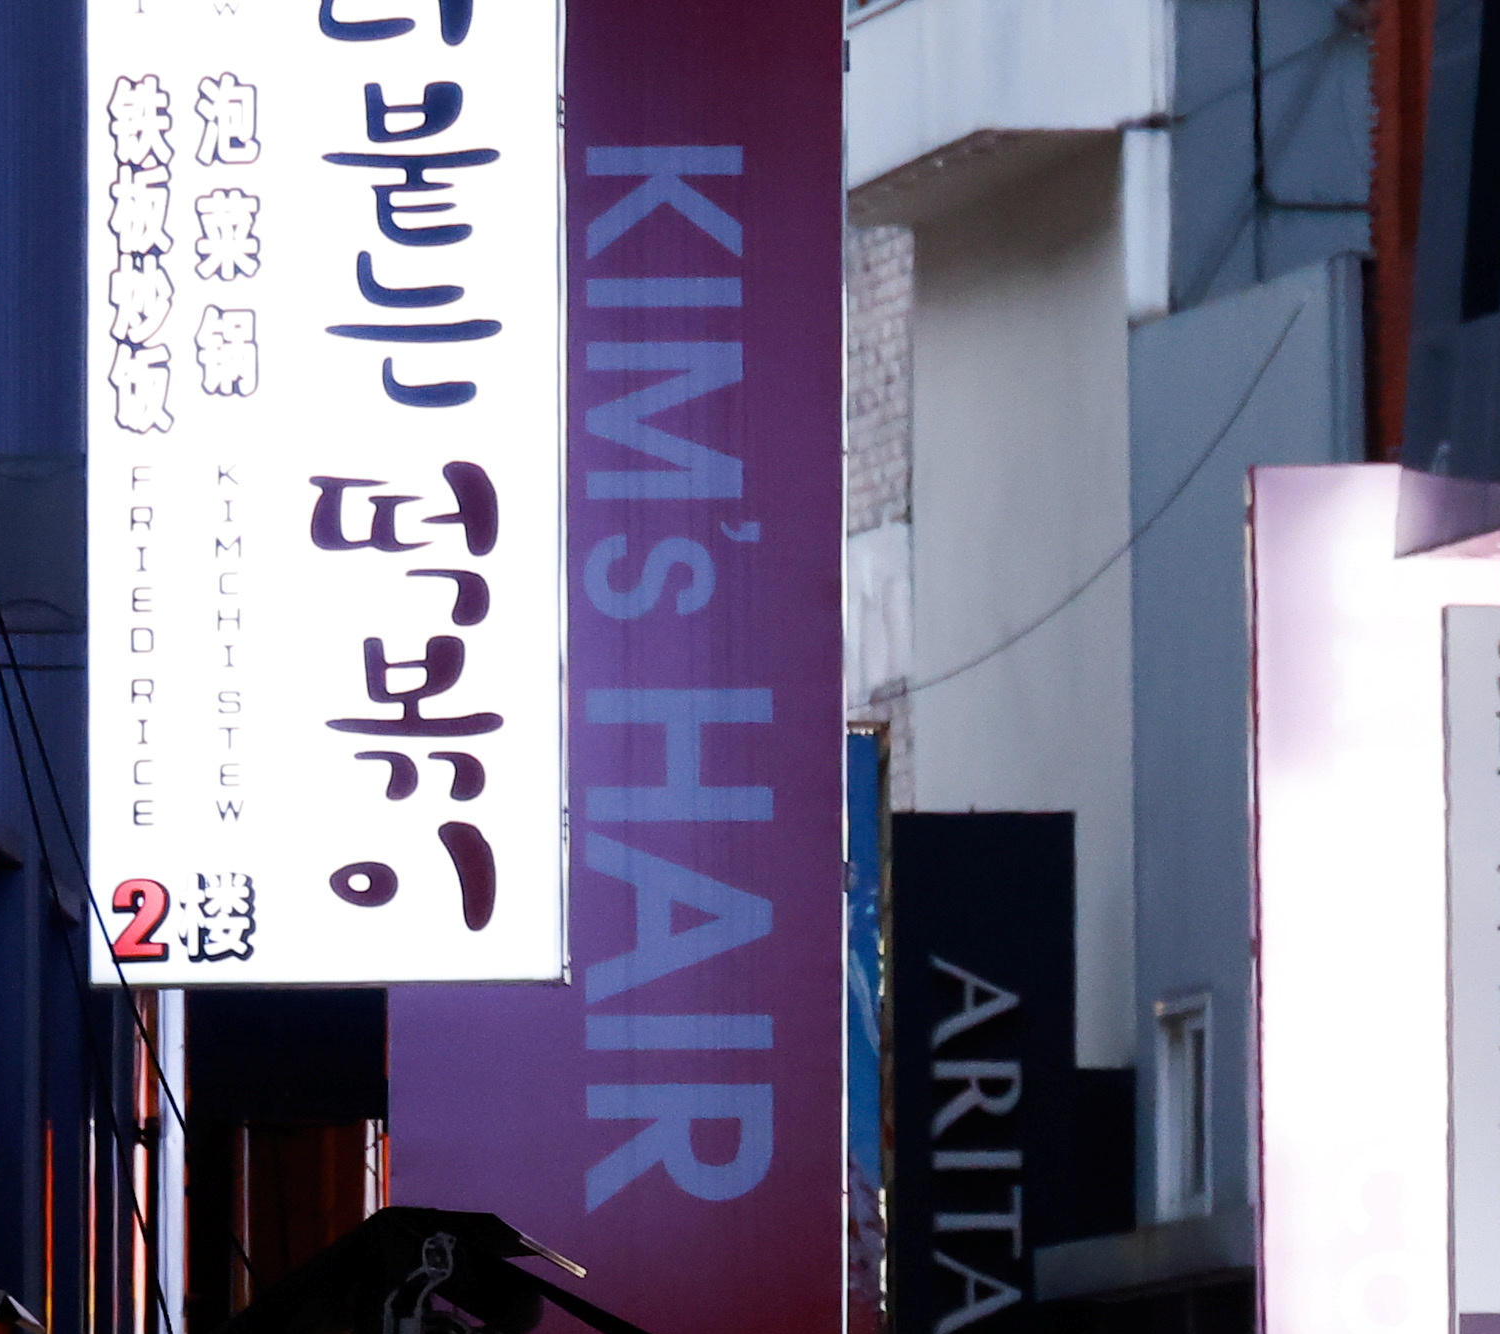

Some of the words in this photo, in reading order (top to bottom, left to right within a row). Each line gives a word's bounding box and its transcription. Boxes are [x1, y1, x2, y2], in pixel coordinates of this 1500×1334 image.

[194, 72, 261, 397] 泡菜锅
[130, 465, 154, 656] FRIED
[214, 464, 244, 669] KIMCHI
[130, 678, 155, 827] RICE
[214, 690, 245, 824] STEW
[310, 460, 505, 932] 떡볶이
[584, 686, 775, 1214] HAIR
